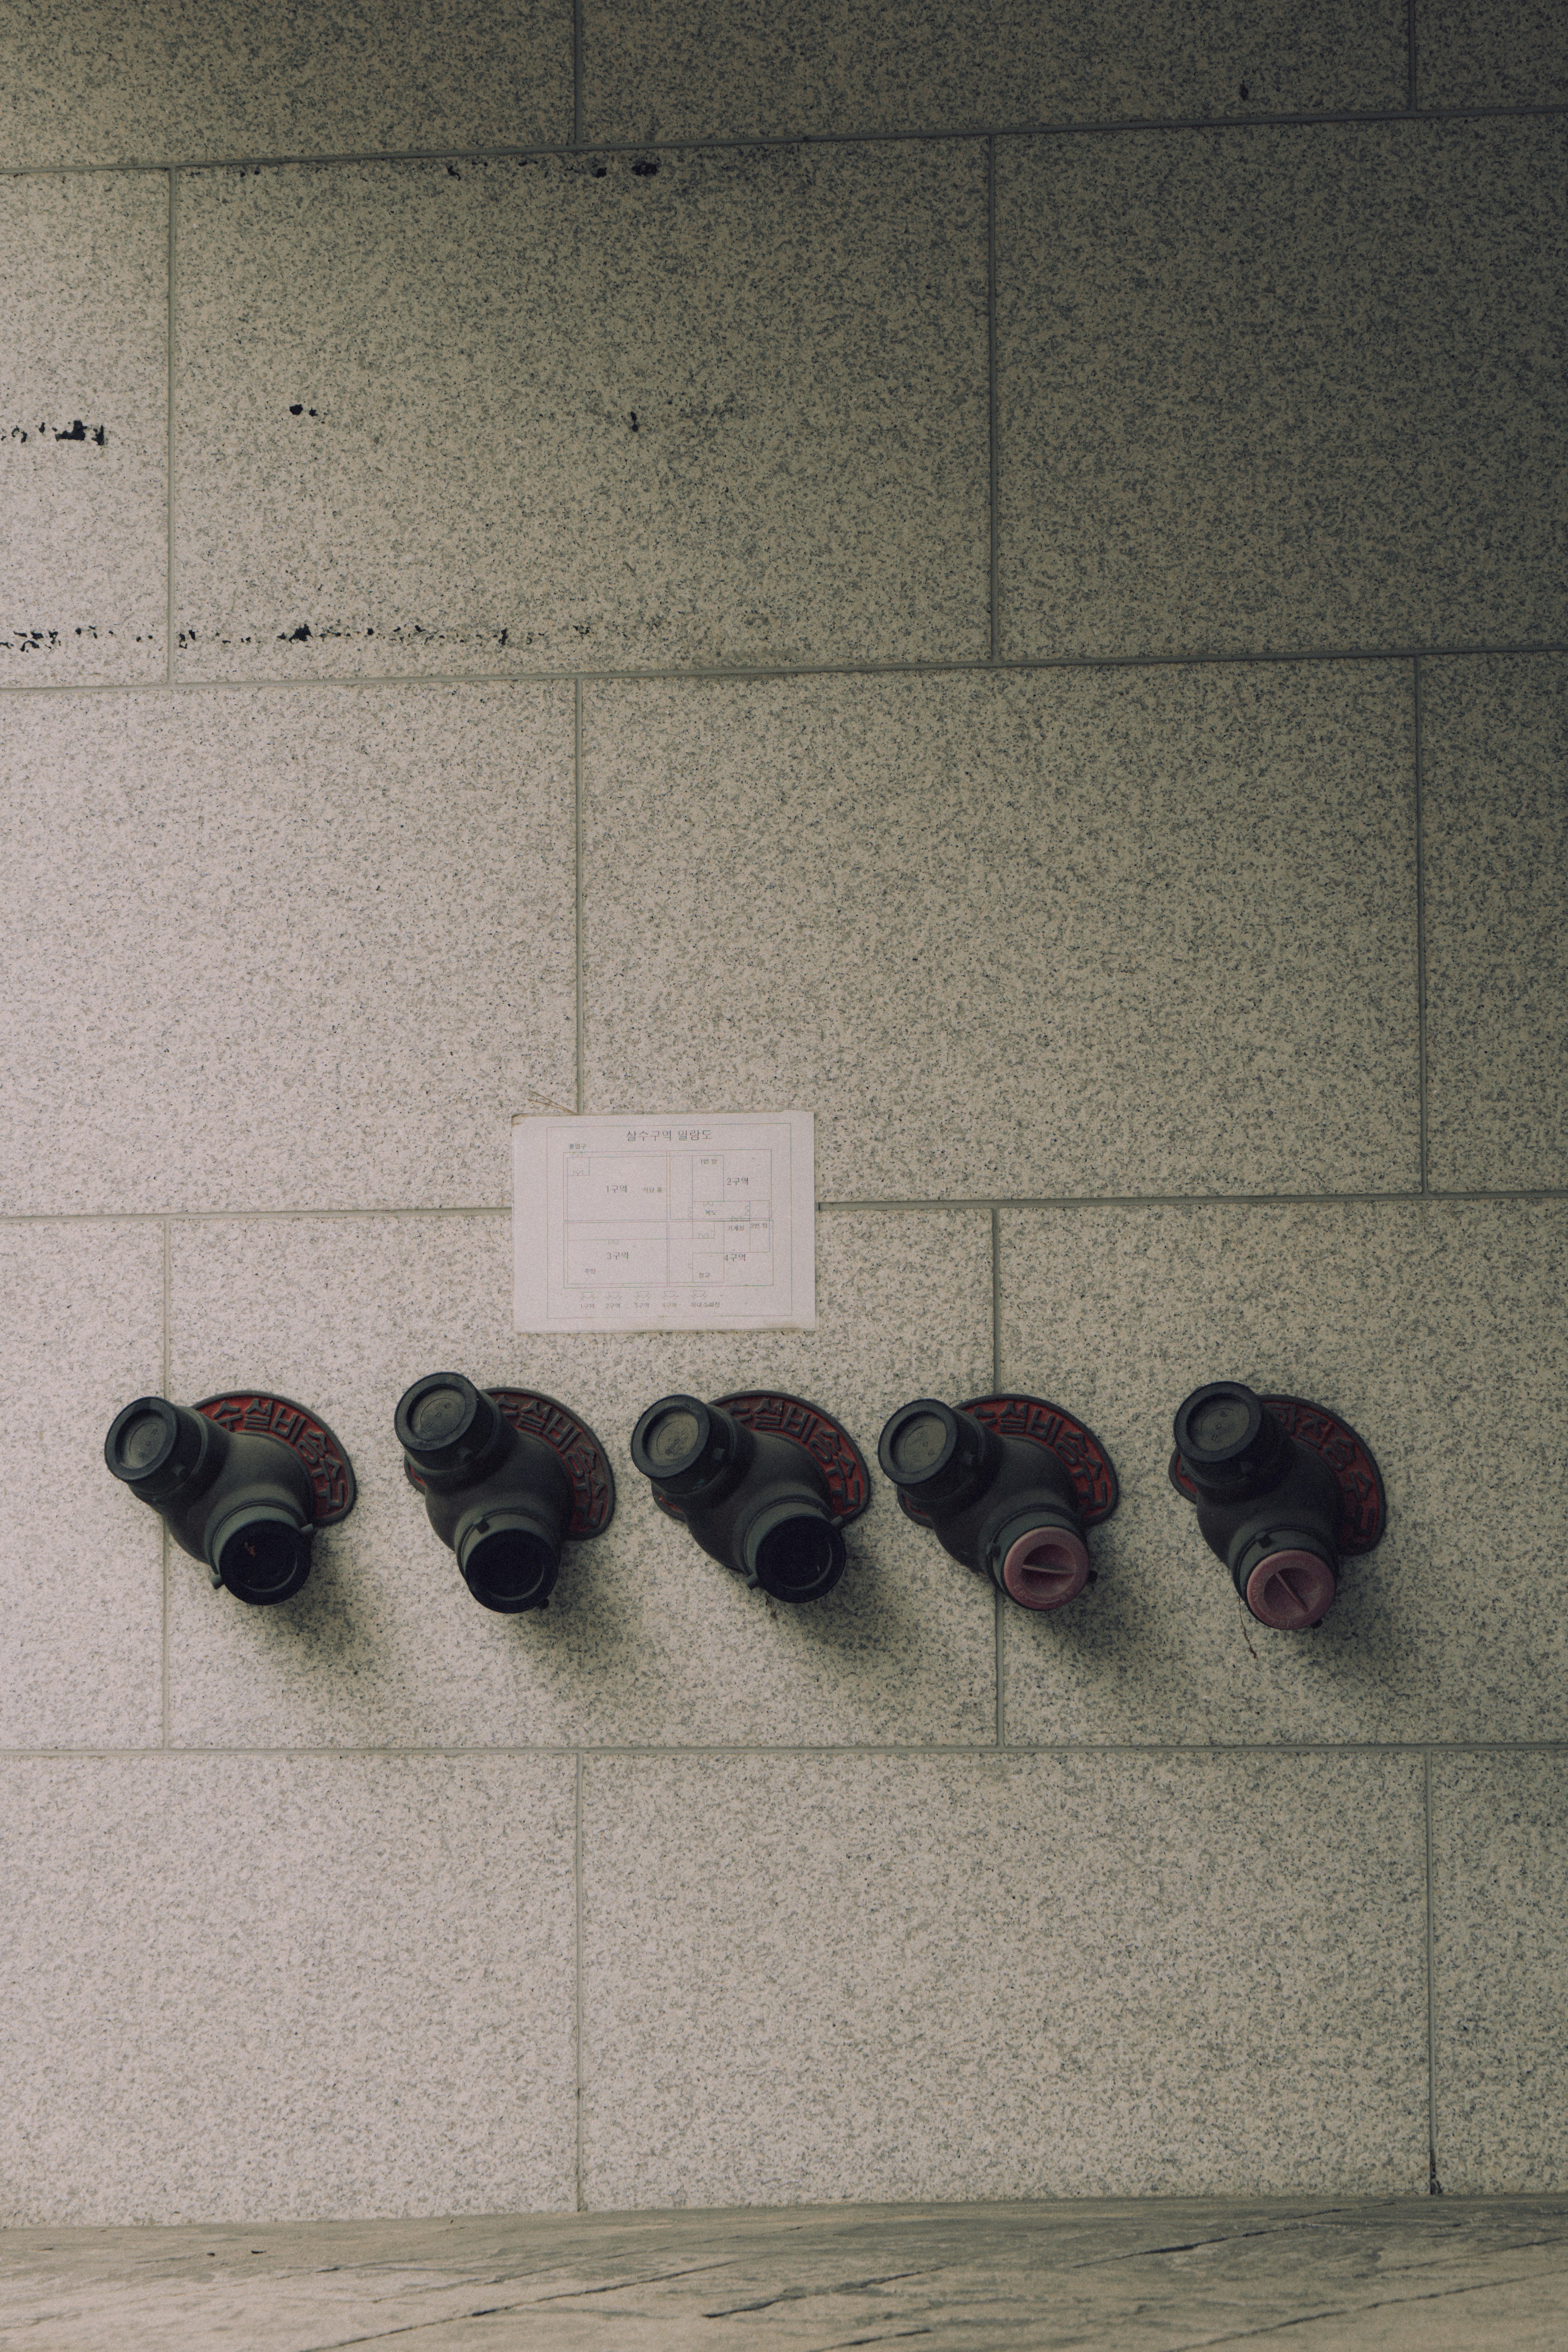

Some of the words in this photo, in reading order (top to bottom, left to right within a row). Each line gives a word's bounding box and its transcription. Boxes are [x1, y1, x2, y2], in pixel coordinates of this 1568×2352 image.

[626, 1130, 672, 1141] 살수구역
[678, 1130, 712, 1141] 일람도
[727, 1177, 748, 1185] 2구역
[606, 1185, 627, 1193] 1구역
[607, 1251, 629, 1260] 3구역
